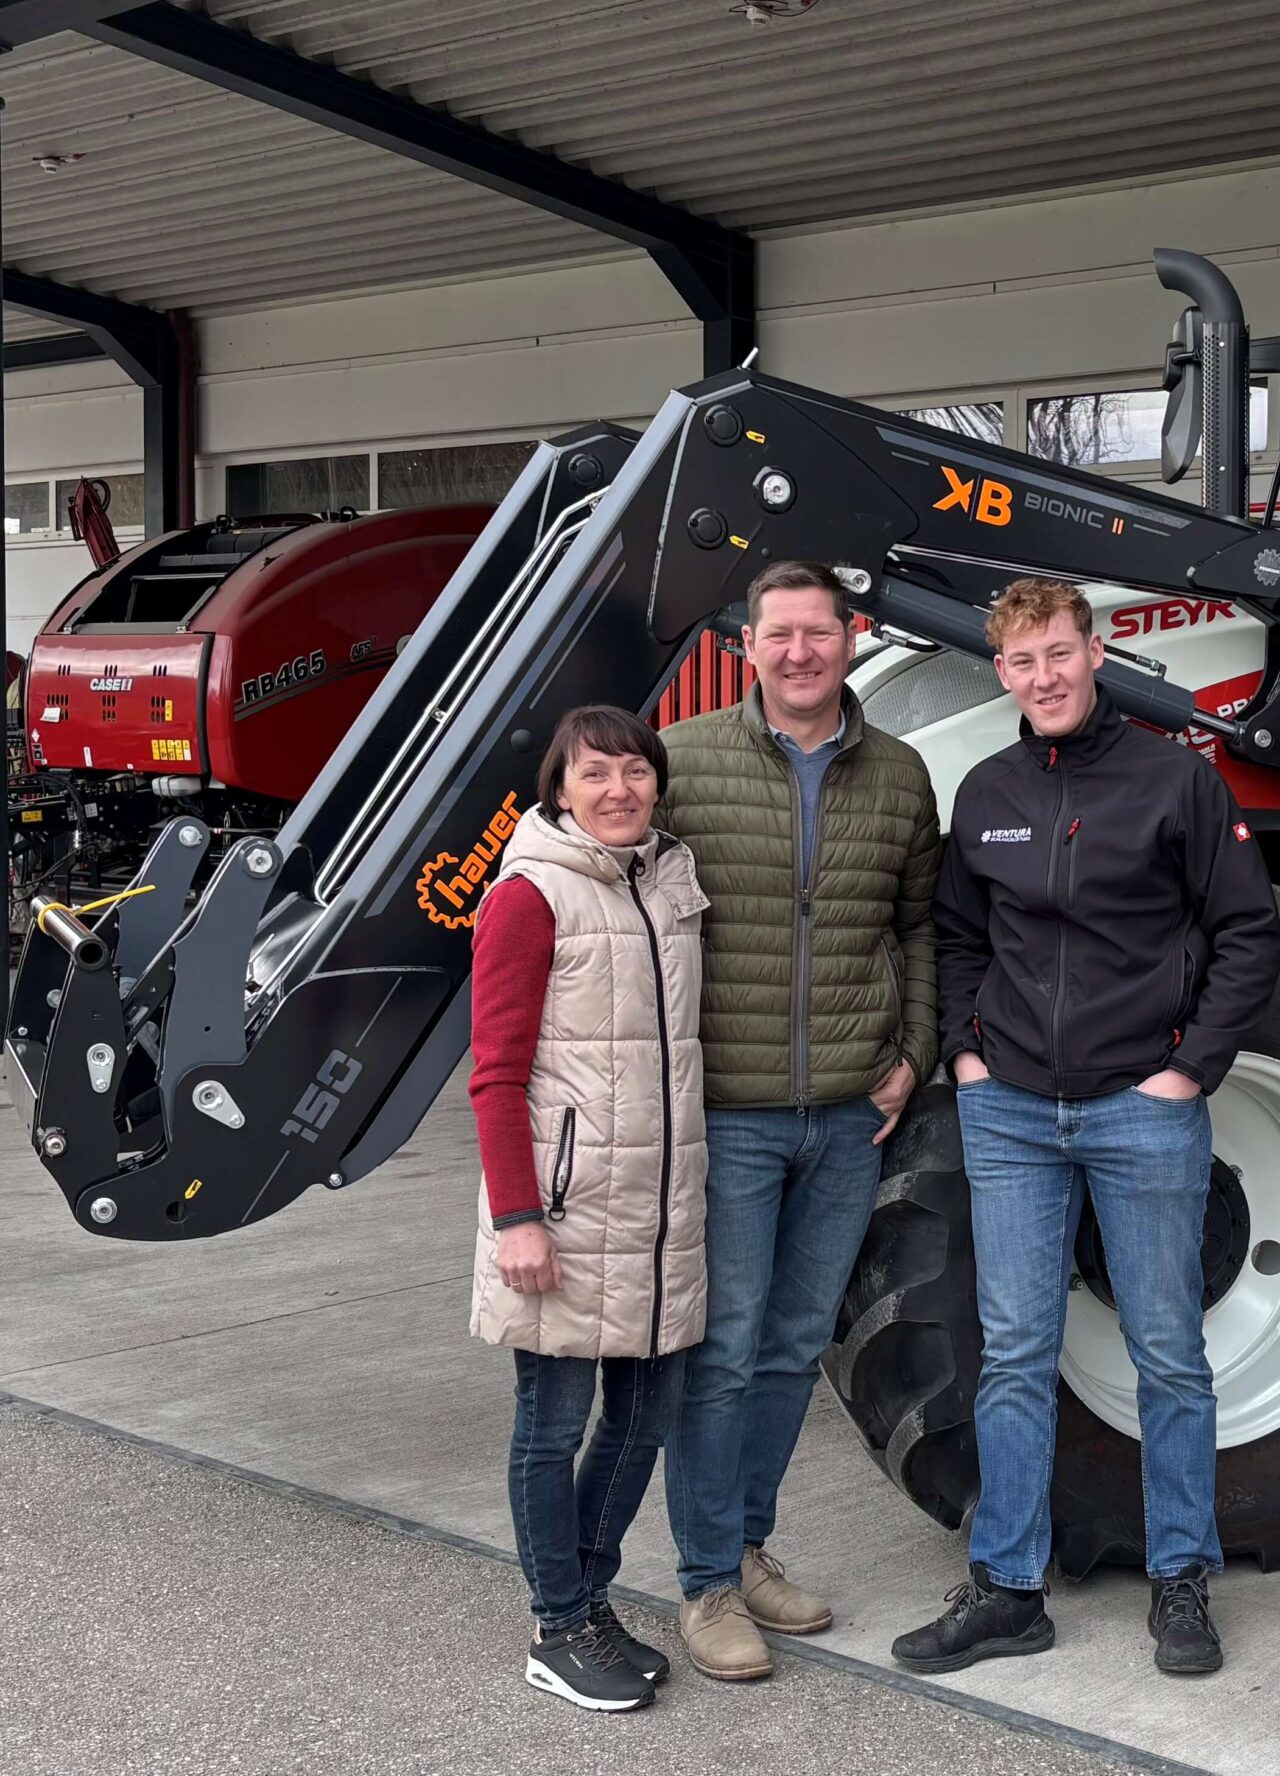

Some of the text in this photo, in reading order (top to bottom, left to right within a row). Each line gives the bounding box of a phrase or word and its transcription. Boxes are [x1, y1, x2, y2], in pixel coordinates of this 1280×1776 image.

[932, 466, 1125, 535] XB BIONIC II
[1110, 599, 1237, 640] STEYR
[89, 678, 121, 691] CASE
[241, 649, 327, 704] RB465
[433, 790, 522, 909] hauer
[991, 827, 1032, 838] VENTURA
[280, 1048, 363, 1144] 150
